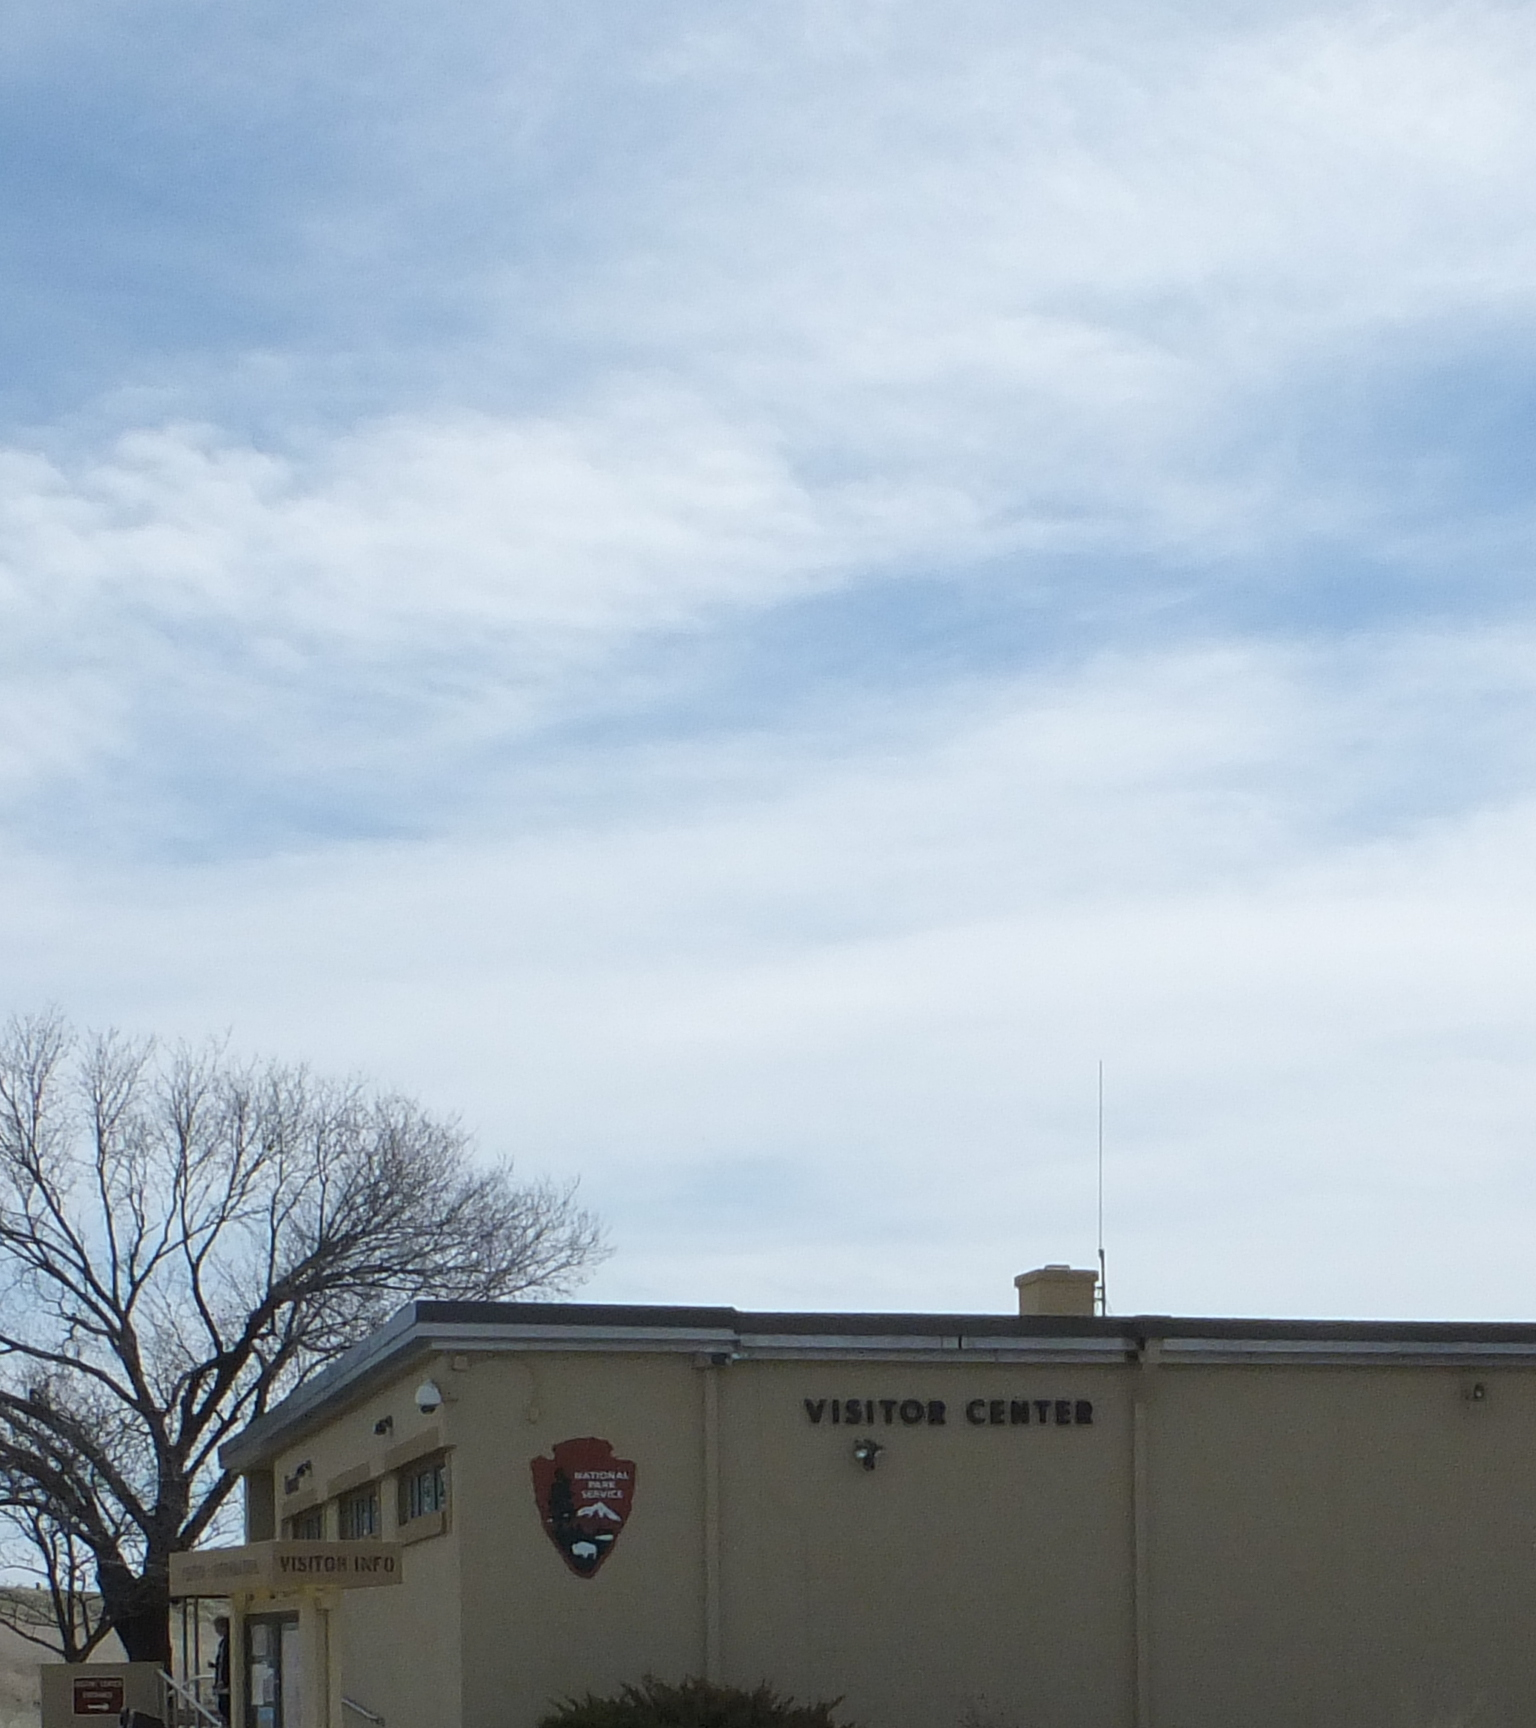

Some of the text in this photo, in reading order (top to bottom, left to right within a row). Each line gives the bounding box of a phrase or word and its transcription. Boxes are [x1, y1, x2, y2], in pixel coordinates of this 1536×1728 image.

[804, 1399, 1094, 1425] VISITOR CENTER
[574, 1471, 629, 1480] NATIONAL
[588, 1480, 616, 1489] PARK
[581, 1489, 624, 1499] SERVICE
[280, 1555, 348, 1573] VISITOR
[354, 1555, 395, 1573] INFO
